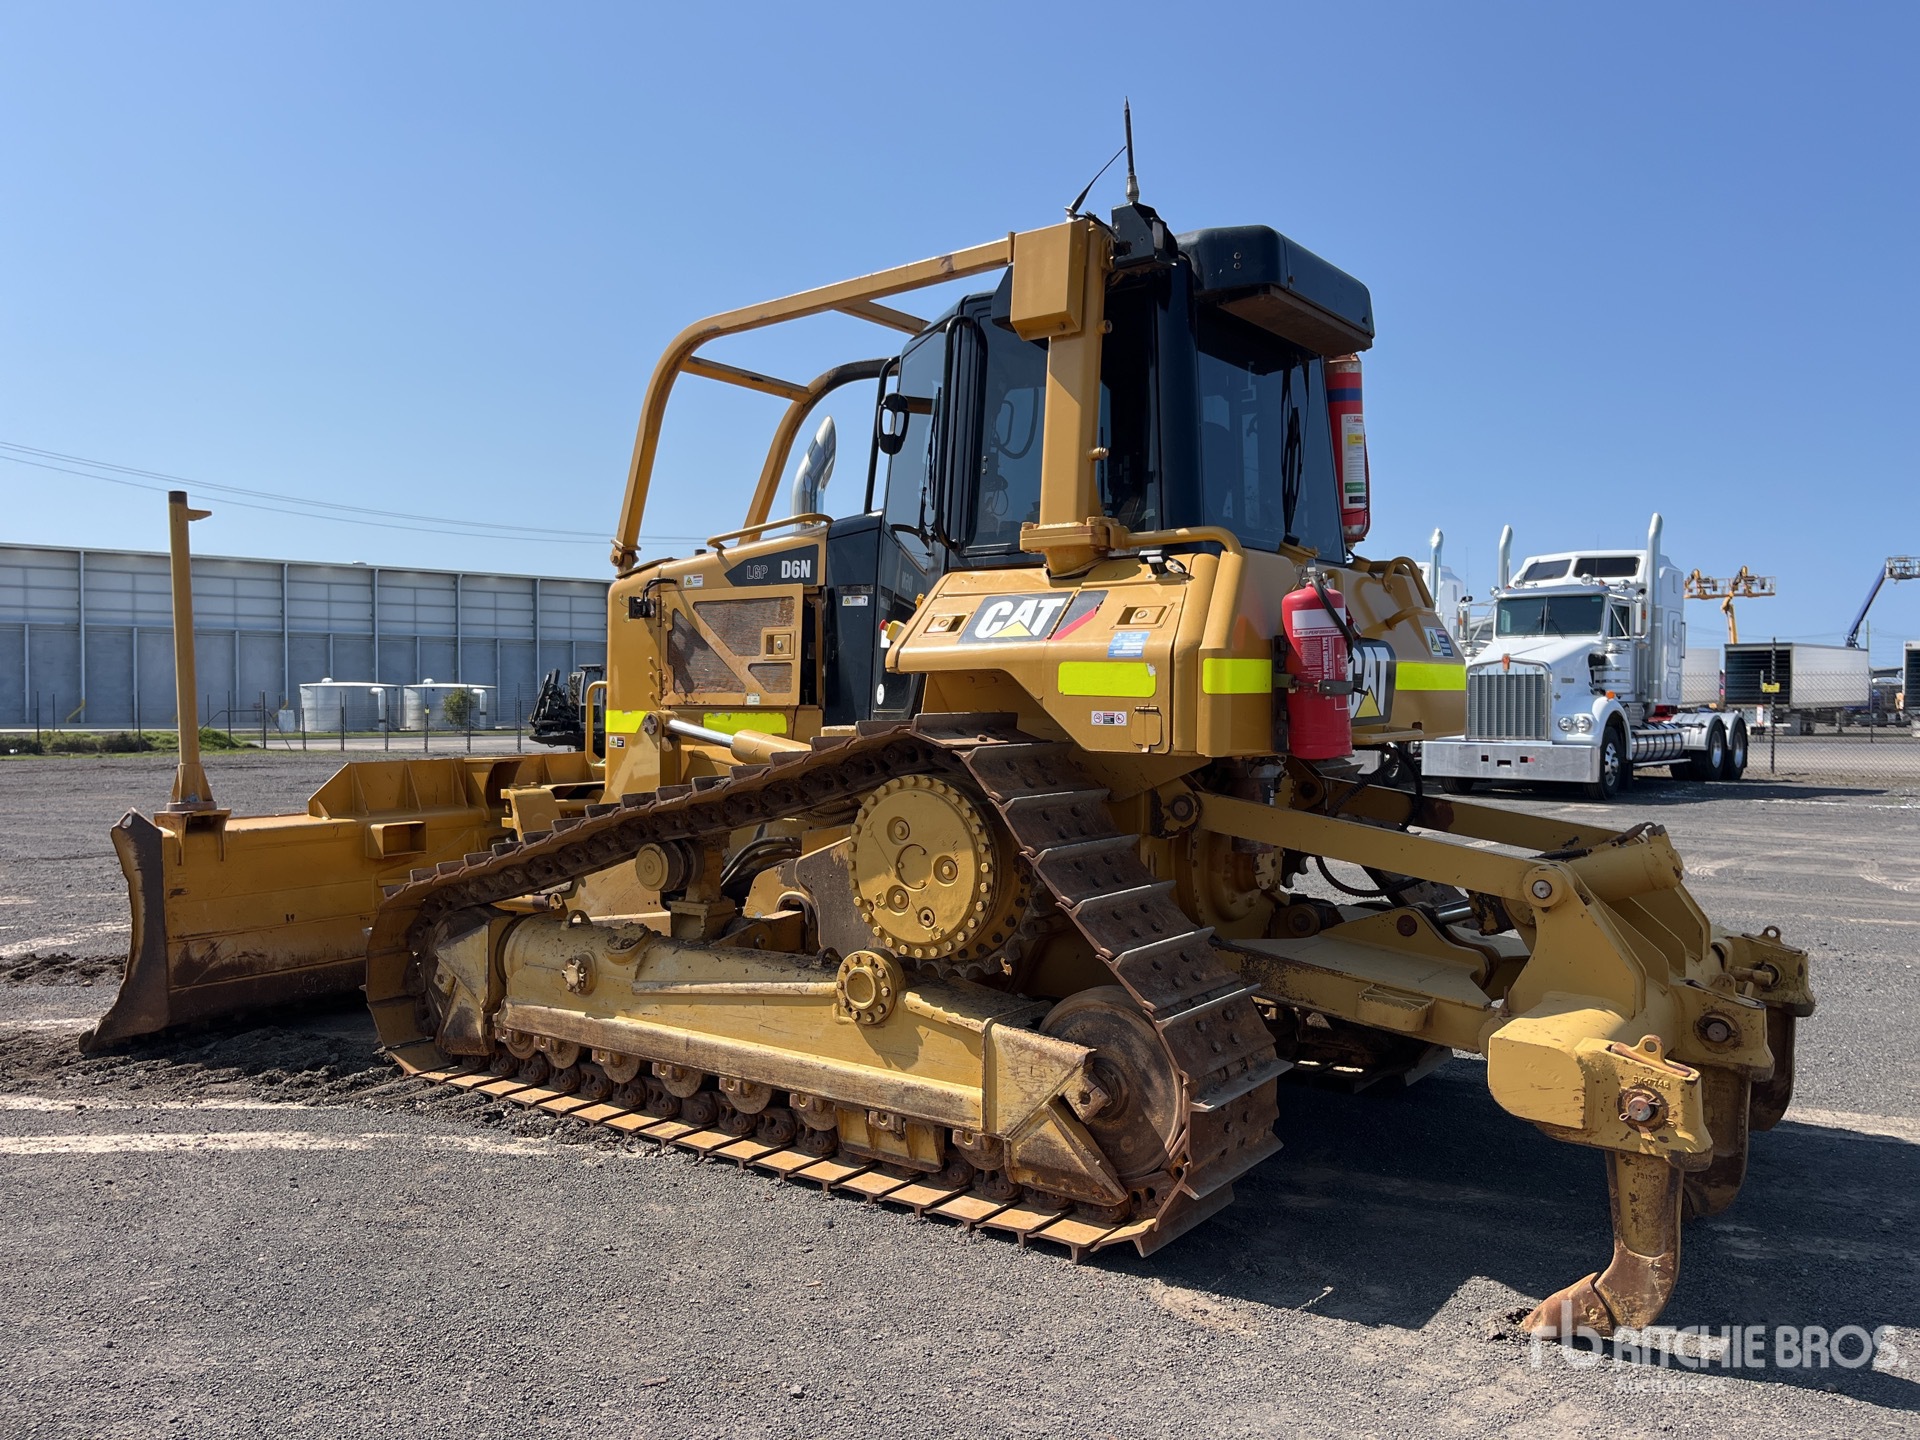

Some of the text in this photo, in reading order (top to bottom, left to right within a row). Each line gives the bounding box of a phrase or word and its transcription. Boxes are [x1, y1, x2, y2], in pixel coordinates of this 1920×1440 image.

[746, 560, 811, 579] LGP D6N
[974, 598, 1067, 639] CAT
[1346, 646, 1391, 719] CAT
